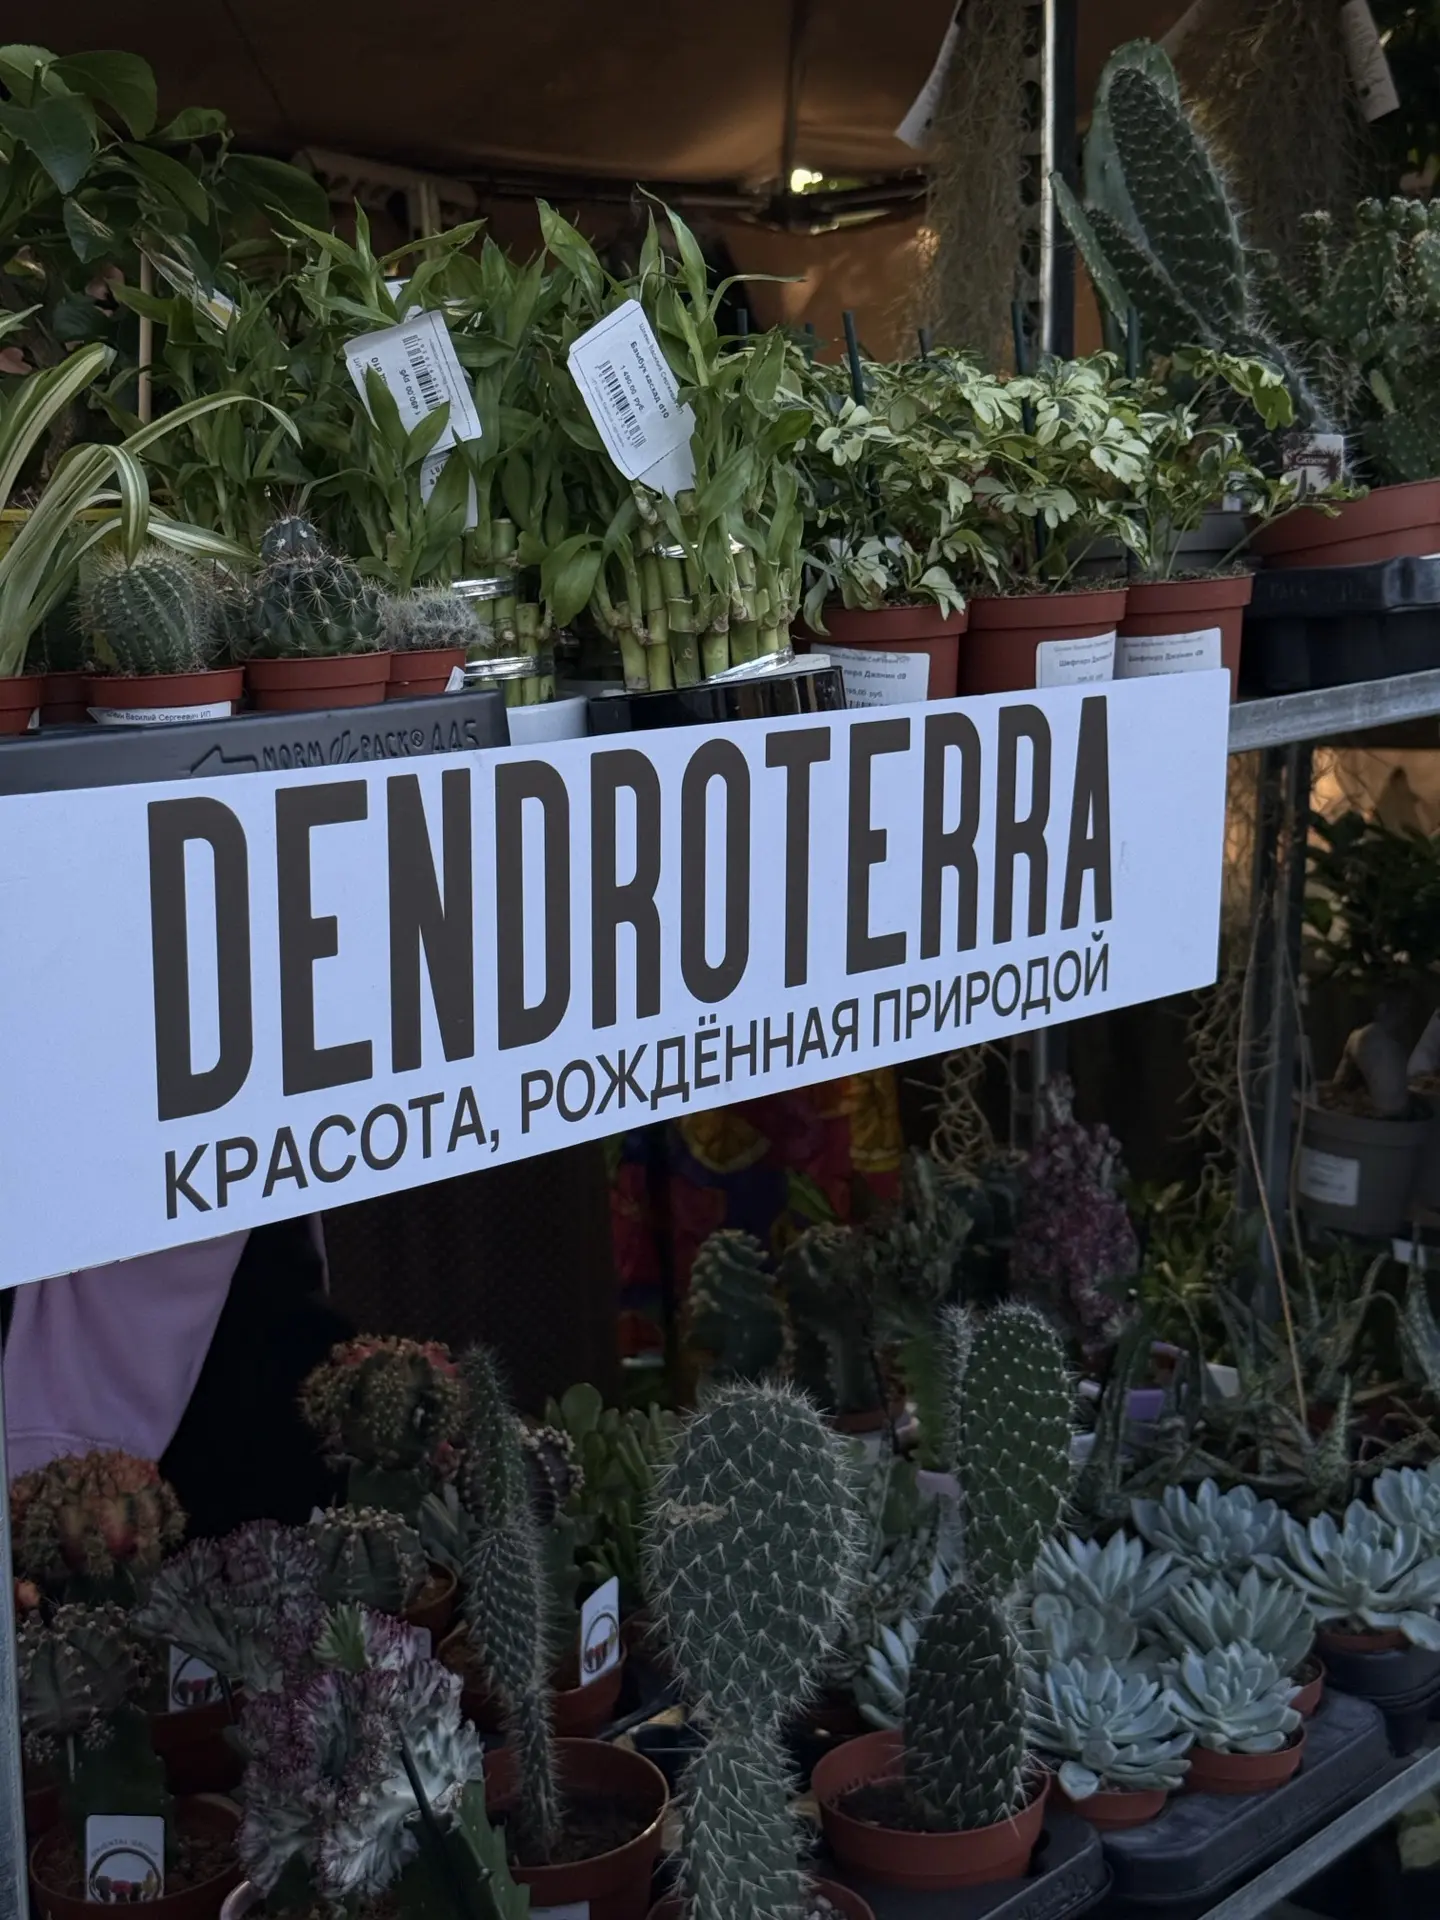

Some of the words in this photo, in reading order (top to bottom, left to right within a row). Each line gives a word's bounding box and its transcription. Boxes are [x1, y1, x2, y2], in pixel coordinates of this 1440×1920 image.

[371, 357, 382, 373] d10
[630, 341, 648, 373] Бамбук
[645, 374, 661, 403] каскад
[658, 403, 669, 418] d10
[126, 711, 156, 721] Василий
[147, 694, 1113, 1122] DENDROTERRA
[164, 1085, 501, 1220] КРАСОТА,
[520, 996, 859, 1134] РОЖДЁННАЯ
[872, 930, 1110, 1048] ПРИРОДОЙ
